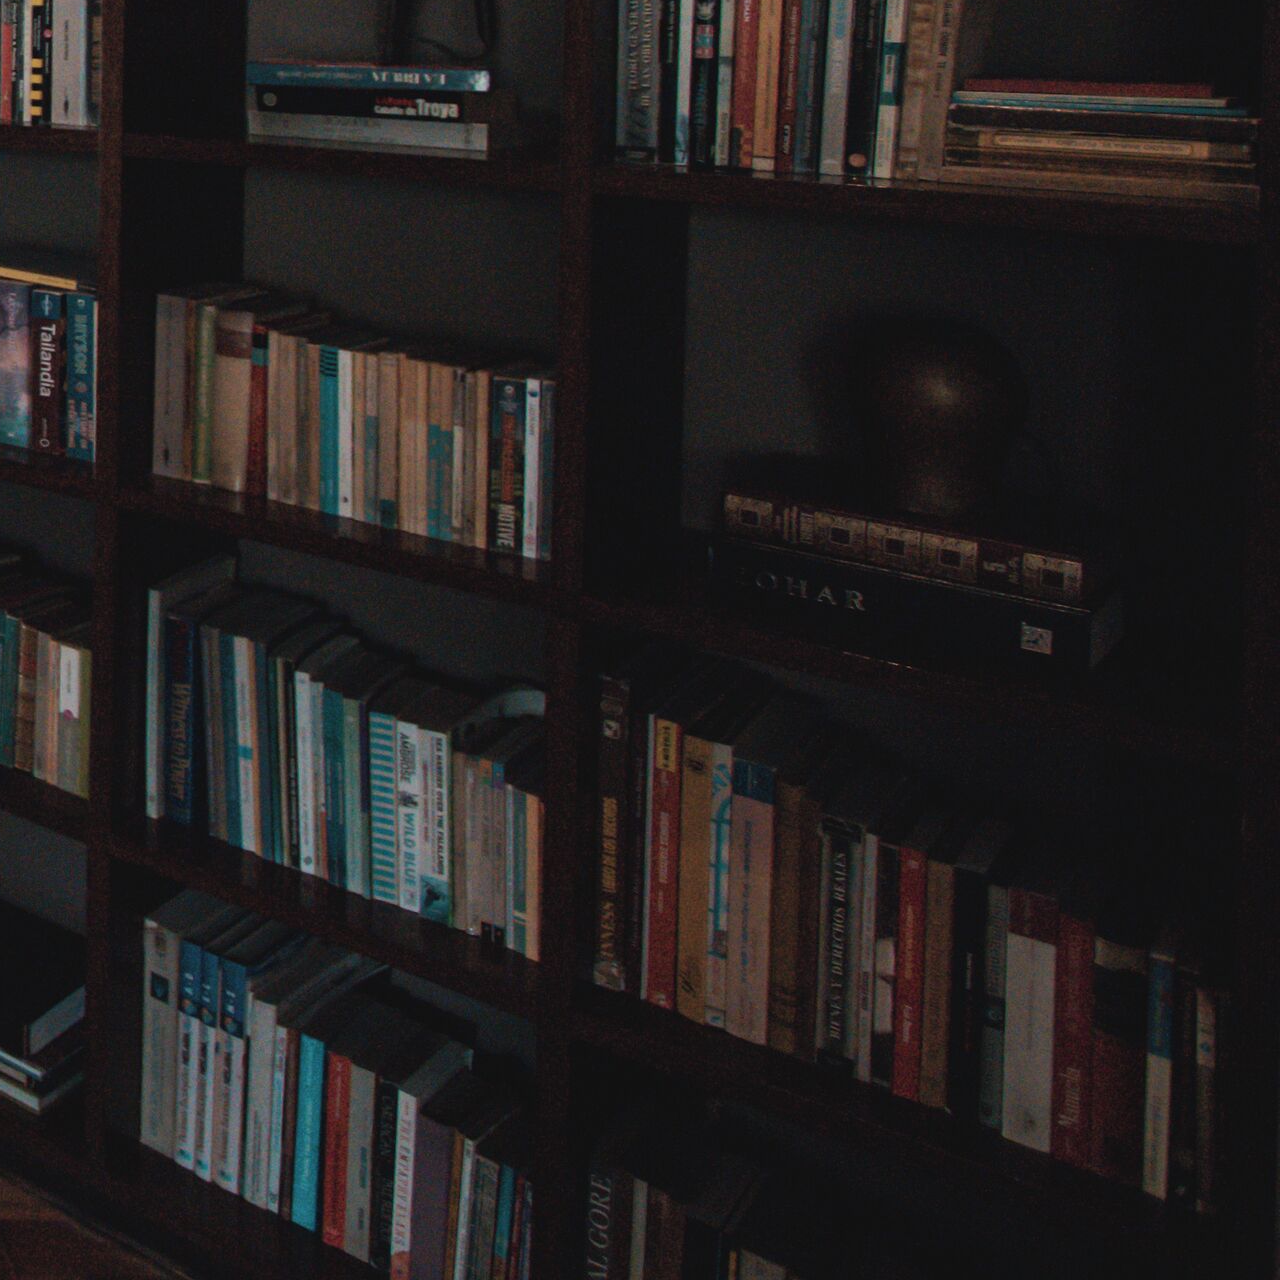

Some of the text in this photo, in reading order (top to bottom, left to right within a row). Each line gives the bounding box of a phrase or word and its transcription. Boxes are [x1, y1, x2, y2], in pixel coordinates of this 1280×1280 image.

[640, 92, 651, 107] DE
[641, 68, 651, 87] LAS
[414, 98, 460, 120] Troya
[39, 323, 57, 397] Tailandia
[497, 504, 515, 549] MOTIVE
[172, 682, 192, 741] Witness
[170, 759, 187, 800] Power
[399, 732, 412, 783] AMBROSE
[402, 813, 417, 887] WILD BLUE
[834, 851, 847, 901] REALES
[831, 906, 845, 975] DERECHOS
[829, 995, 843, 1039] BIENES
[588, 1173, 611, 1249] GORE
